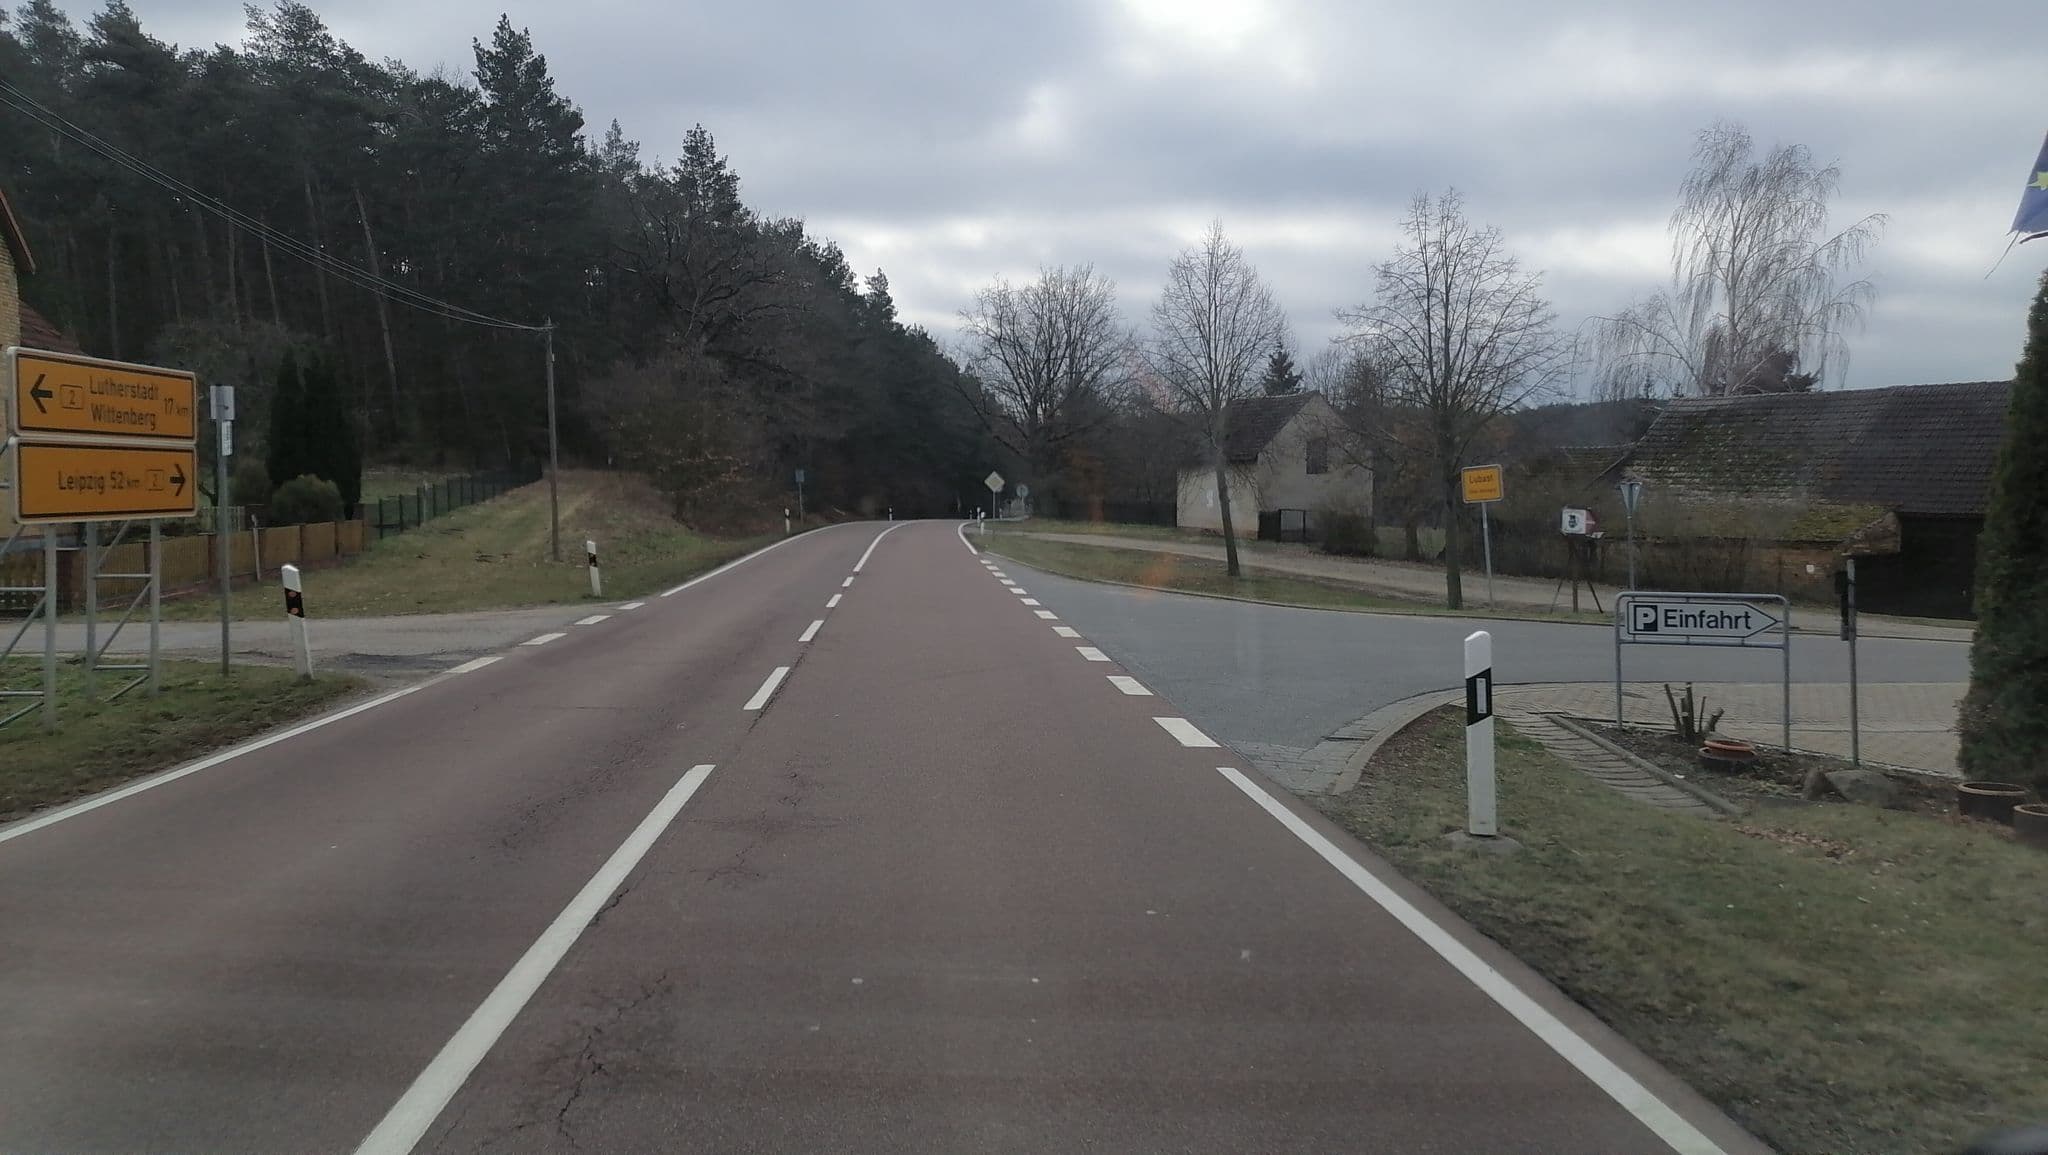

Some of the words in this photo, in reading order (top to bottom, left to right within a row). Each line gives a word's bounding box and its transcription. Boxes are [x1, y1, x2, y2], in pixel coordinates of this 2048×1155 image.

[68, 390, 76, 406] 2
[89, 375, 159, 401] Lutherstadt
[90, 403, 156, 431] Wittenberg
[164, 397, 174, 416] 17
[176, 405, 189, 417] km
[58, 470, 105, 495] Leipzig
[110, 471, 124, 490] 52
[126, 478, 140, 489] km
[1635, 606, 1657, 631] P
[1663, 608, 1752, 630] Einfahrt
